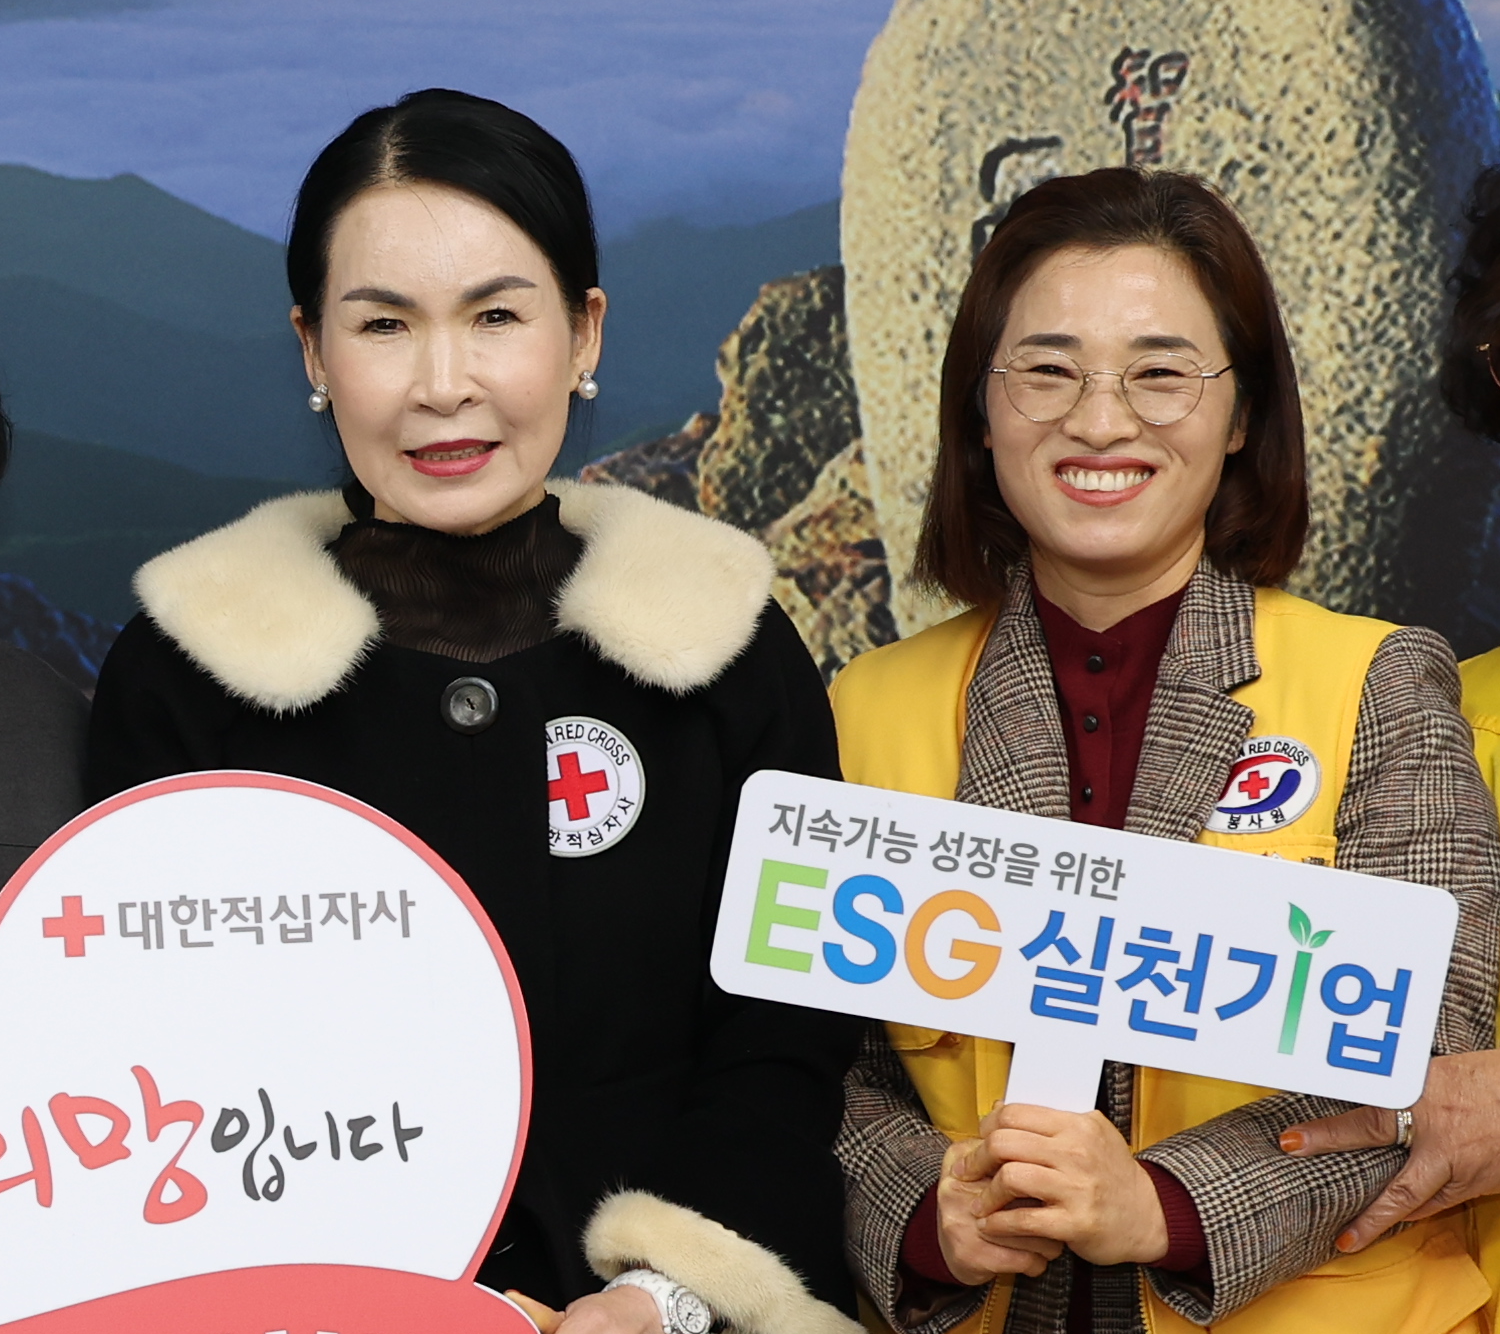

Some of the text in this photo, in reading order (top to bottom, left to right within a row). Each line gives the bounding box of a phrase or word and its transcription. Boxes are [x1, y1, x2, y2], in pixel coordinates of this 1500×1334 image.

[554, 723, 585, 742] RED
[587, 727, 631, 766] CROSS
[1248, 741, 1271, 755] RED
[1273, 741, 1310, 767] CROSS
[1227, 808, 1286, 830] 봉사원
[766, 803, 1126, 902] 지속가능 성장을 위한
[117, 889, 416, 951] 대한적십자사
[744, 859, 1413, 1078] ESG 실천기업
